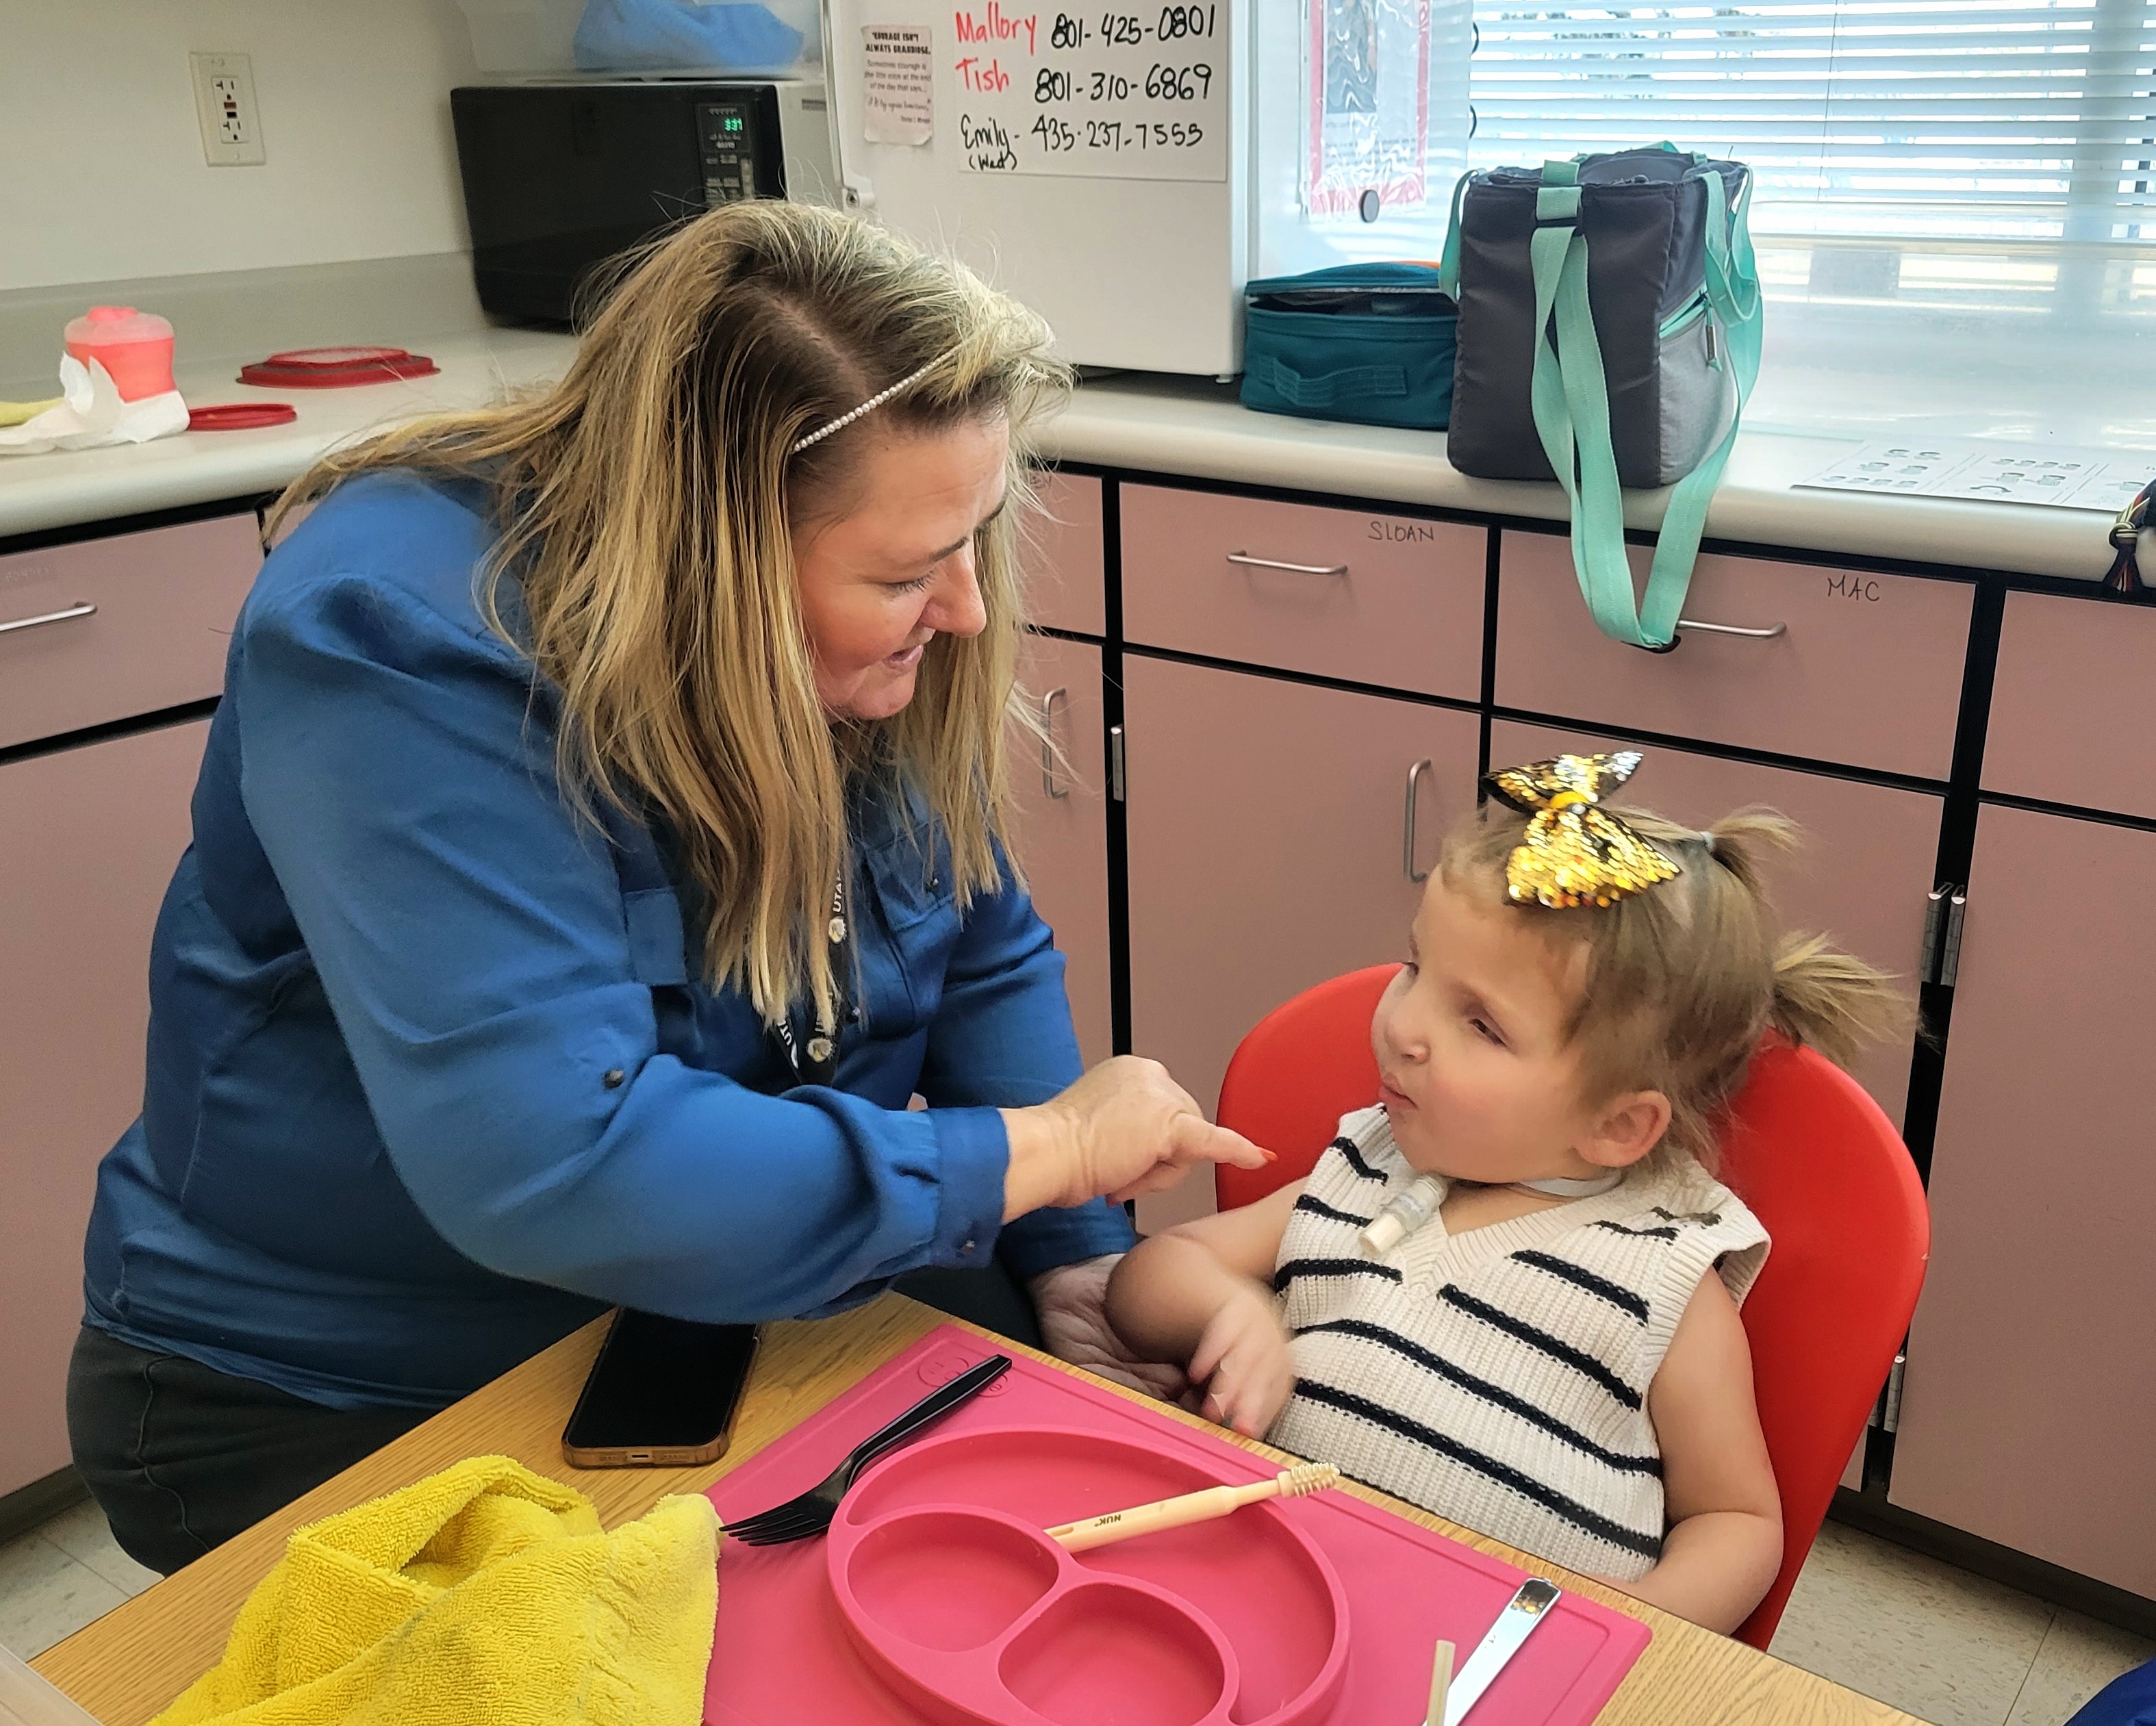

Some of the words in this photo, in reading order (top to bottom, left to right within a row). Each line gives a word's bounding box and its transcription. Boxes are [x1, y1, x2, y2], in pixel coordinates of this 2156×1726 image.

[956, 1, 1037, 56] Mallory
[865, 43, 891, 53] ALWAYS
[955, 58, 1010, 93] Tish
[1367, 521, 1434, 542] SLOAN
[1827, 574, 1880, 602] MAC
